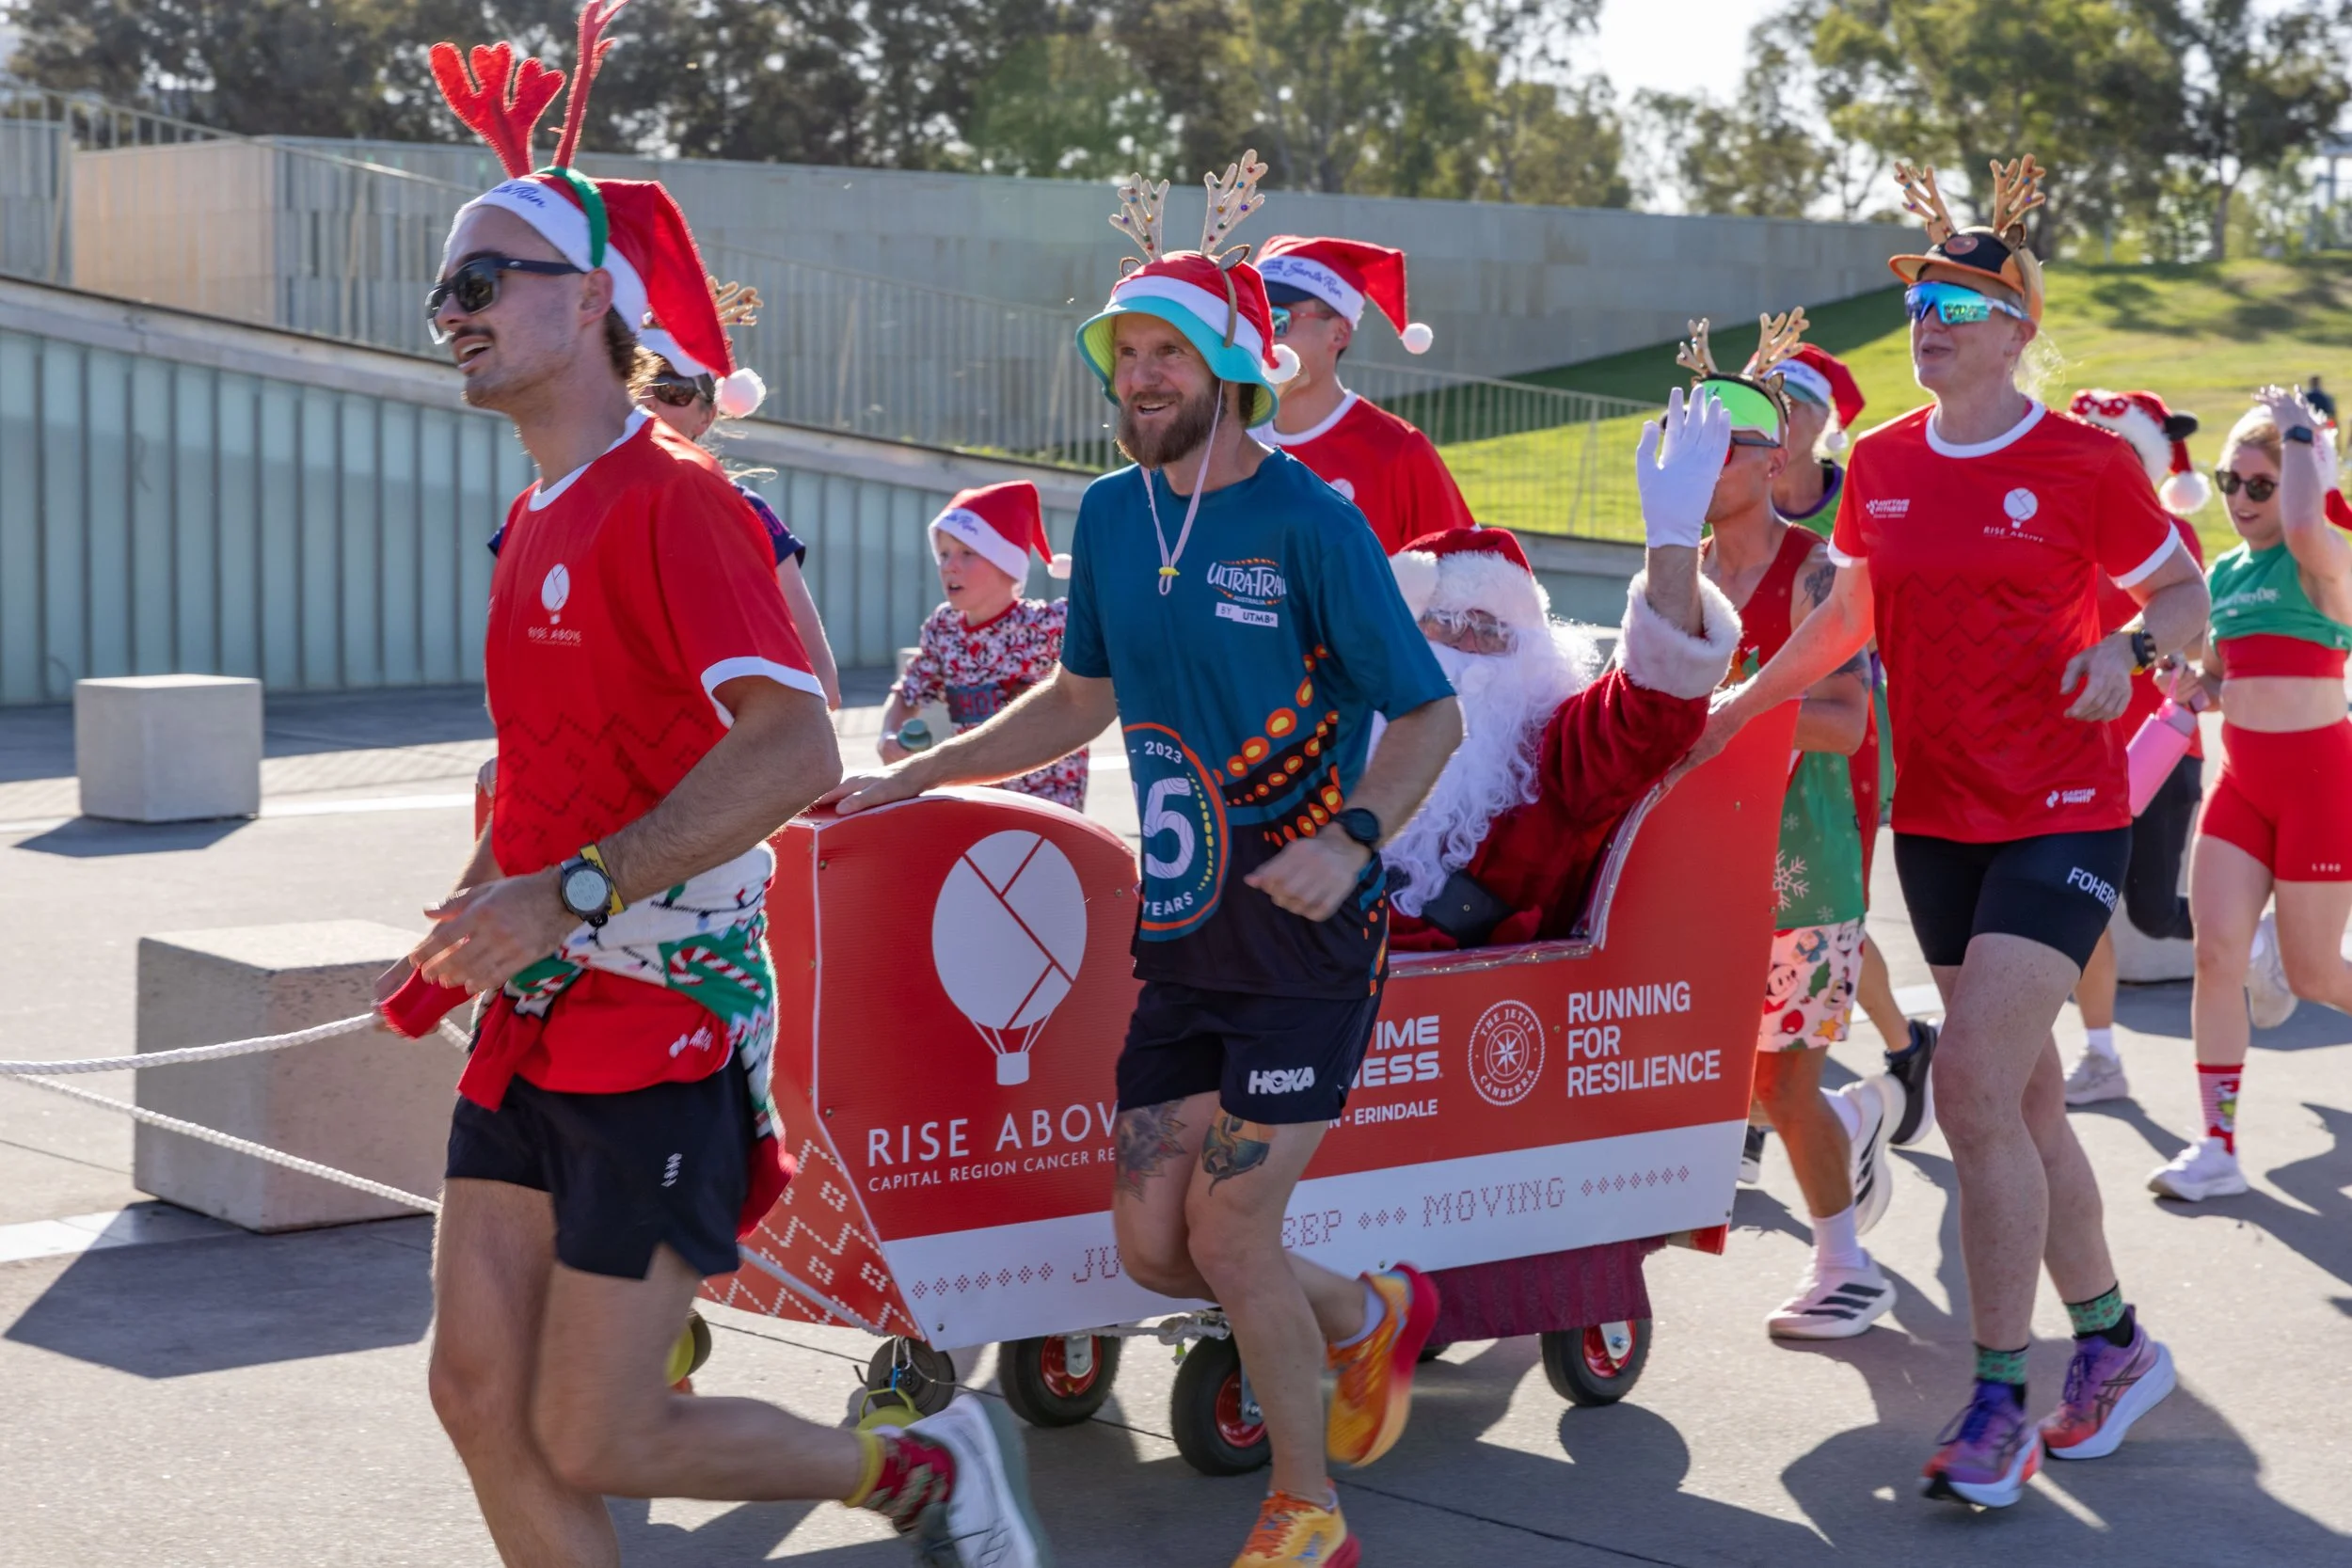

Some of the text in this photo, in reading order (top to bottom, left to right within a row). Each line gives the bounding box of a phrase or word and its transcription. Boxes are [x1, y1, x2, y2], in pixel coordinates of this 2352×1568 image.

[1282, 261, 1323, 283] Santa
[1324, 275, 1343, 299] Run
[1983, 526, 2006, 535] RISE
[1220, 605, 1232, 616] BY
[1144, 740, 1184, 765] 2023
[1568, 980, 1691, 1024] RUNNING
[1375, 1015, 1439, 1051] IME
[1480, 1008, 1535, 1037] THE JETTY
[1568, 1025, 1621, 1061] FOR
[1248, 1066, 1315, 1095] HOKA
[1480, 1069, 1535, 1099] CANBERRA
[1567, 1049, 1721, 1098] RESILIENCE
[1355, 1099, 1438, 1125] ERINDALE
[868, 1099, 1119, 1167] RISE ABOV
[868, 1147, 1116, 1192] CAPITAL REGION CANCER RE
[1073, 1178, 1565, 1283] JU EEP MOVING
